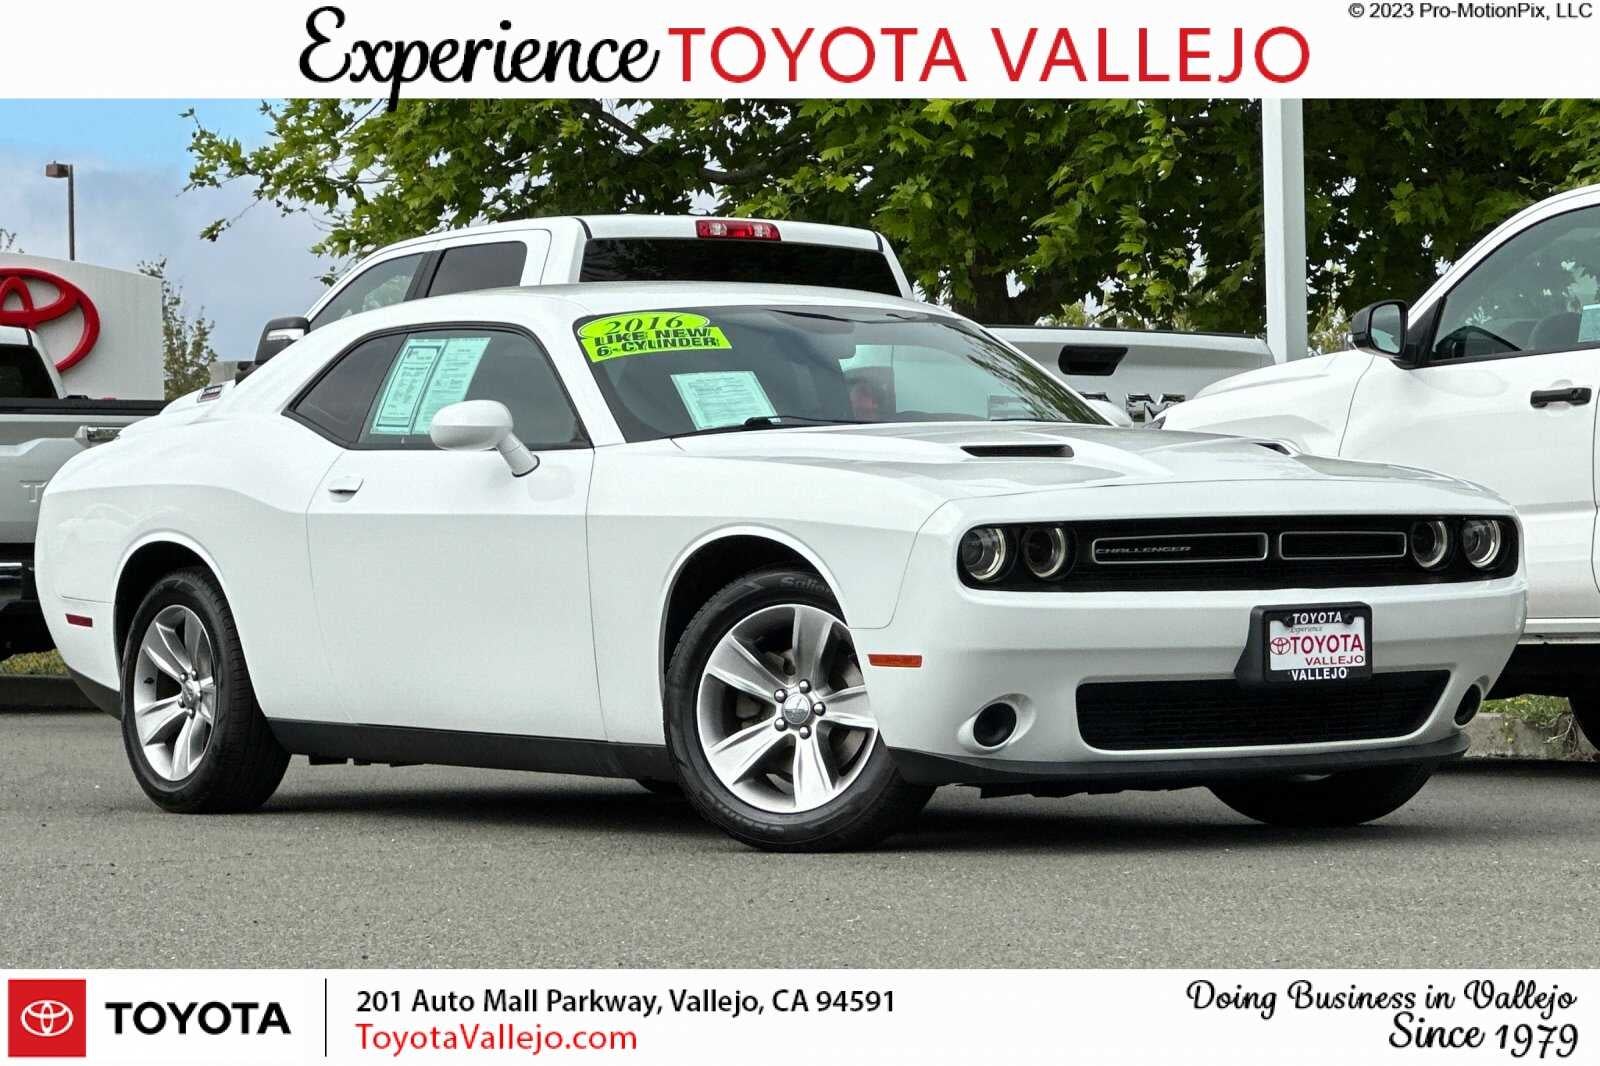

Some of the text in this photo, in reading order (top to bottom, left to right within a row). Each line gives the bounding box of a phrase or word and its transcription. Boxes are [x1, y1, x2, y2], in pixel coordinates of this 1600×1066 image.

[604, 315, 683, 335] 2016
[595, 327, 711, 346] LIKE NEW
[596, 337, 720, 356] 6-CYLINDER
[1095, 545, 1192, 554] CHALLENGER
[1293, 611, 1343, 625] TOYOTA
[1290, 633, 1364, 654] TOYOTA
[1305, 655, 1365, 666] VALLEJO
[1291, 667, 1348, 681] VALLEJO
